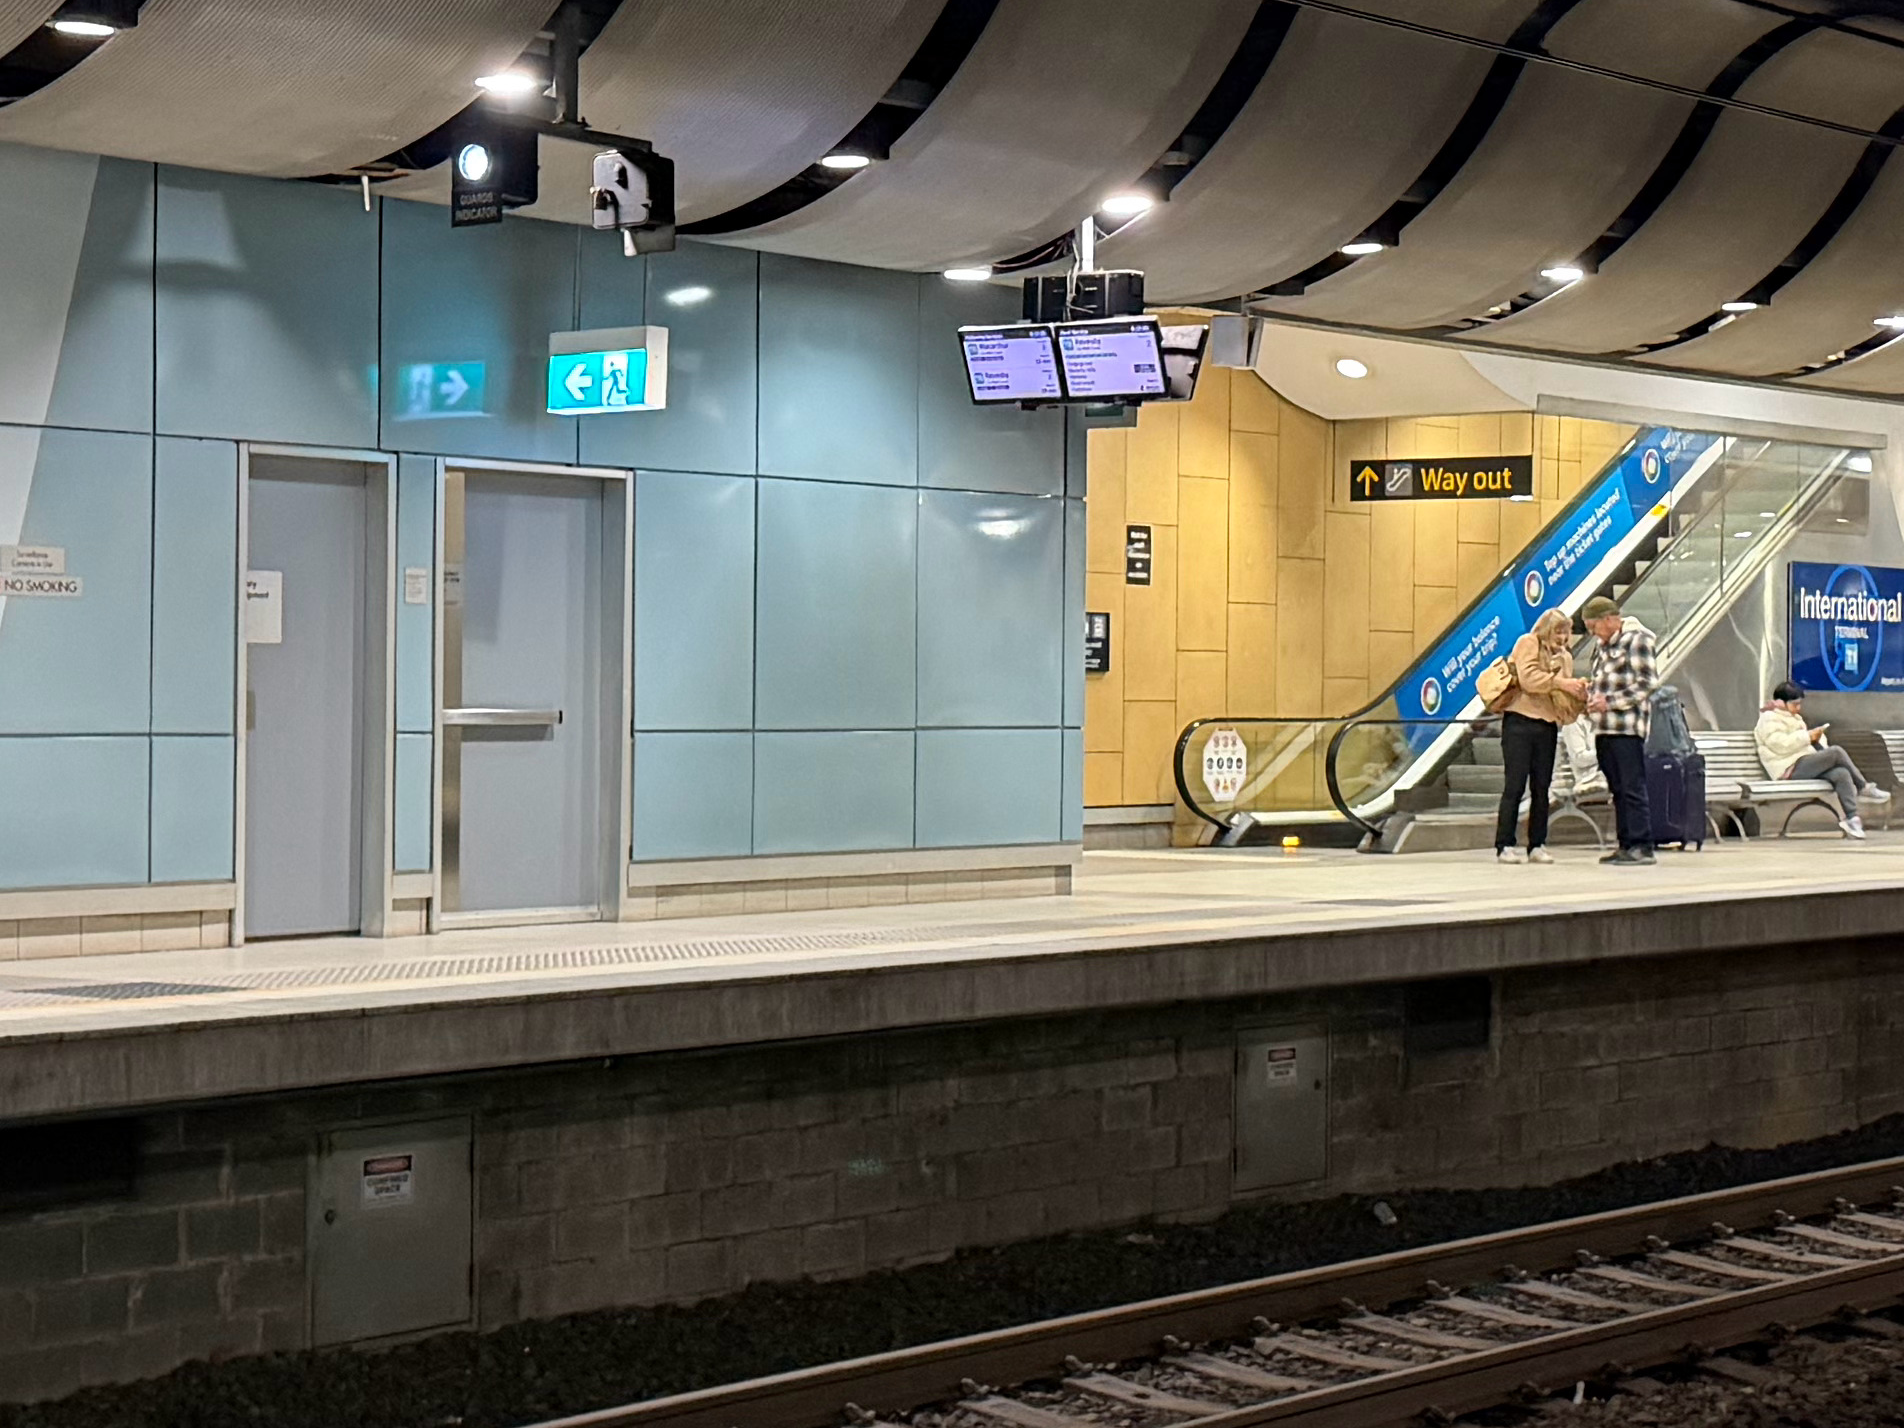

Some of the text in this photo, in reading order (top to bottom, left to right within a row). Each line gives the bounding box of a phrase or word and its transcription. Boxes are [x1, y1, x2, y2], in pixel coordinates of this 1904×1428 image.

[1420, 467, 1512, 496] Way out
[1544, 487, 1621, 572] Top up machines located
[1563, 553, 1576, 570] the
[1574, 533, 1595, 558] ticket
[1593, 515, 1613, 542] gates
[4, 578, 78, 593] NO SMOKING
[1800, 587, 1902, 622] International
[1457, 642, 1473, 668] your
[1472, 615, 1500, 648] balance
[1447, 667, 1467, 693] cover
[1466, 651, 1482, 677] your
